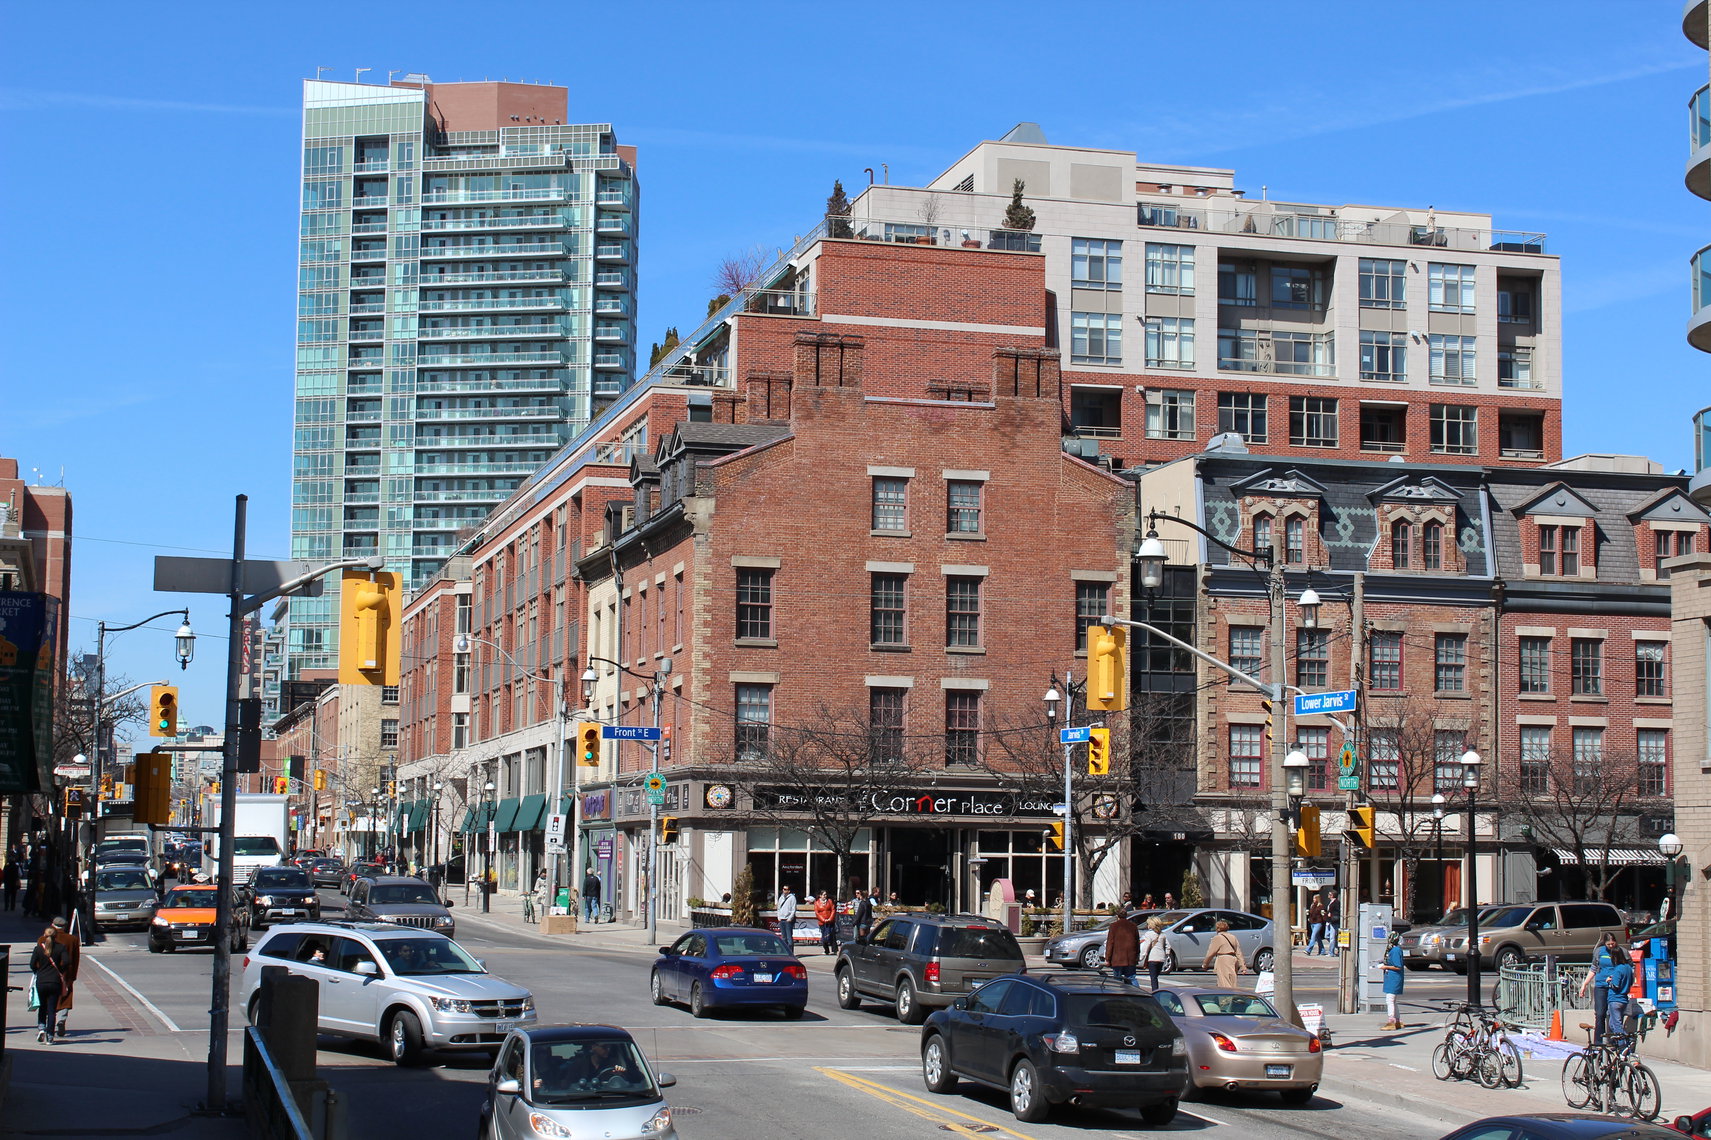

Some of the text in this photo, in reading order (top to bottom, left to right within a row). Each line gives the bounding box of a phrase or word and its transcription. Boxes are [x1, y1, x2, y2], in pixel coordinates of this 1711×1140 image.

[0, 598, 32, 607] RENCE
[1301, 697, 1322, 710] Lower
[1322, 693, 1343, 708] Jarvis
[614, 727, 636, 737] Front
[643, 728, 649, 737] E
[1067, 730, 1080, 739] Jarvis
[1340, 777, 1357, 787] NORTH
[871, 790, 957, 813] Corner
[961, 795, 1003, 814] Place
[1019, 800, 1053, 811] LOUNG
